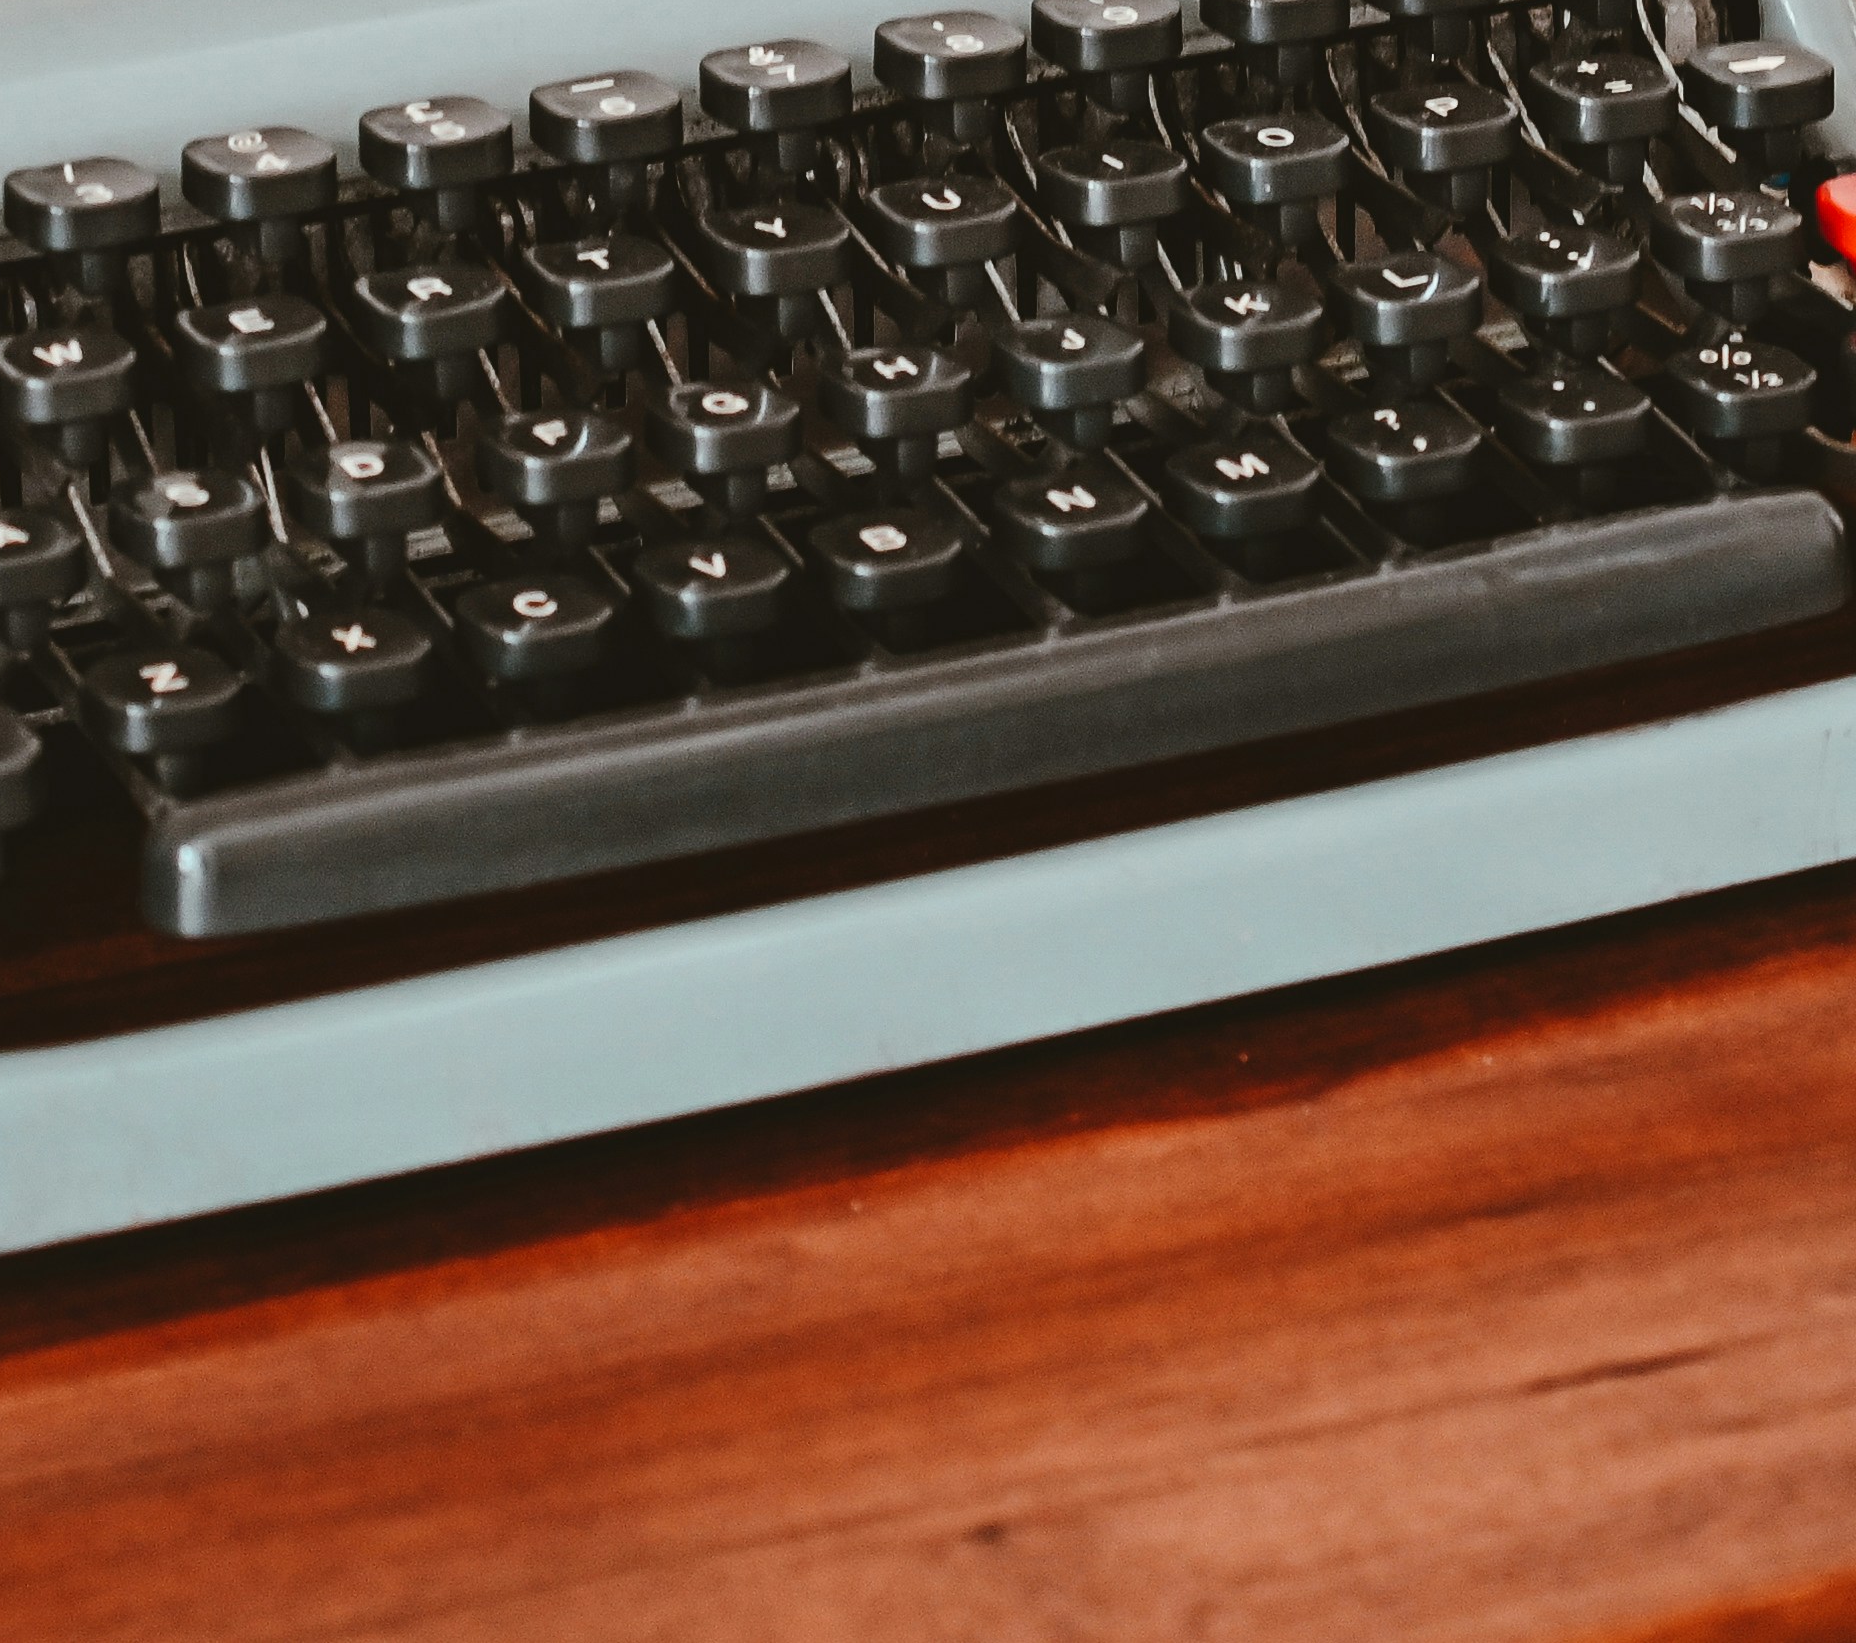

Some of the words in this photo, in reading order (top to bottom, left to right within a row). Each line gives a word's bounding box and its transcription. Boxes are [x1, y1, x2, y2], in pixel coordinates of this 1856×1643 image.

[33, 339, 83, 367] W
[407, 277, 453, 301] R
[577, 248, 609, 270] T
[754, 217, 786, 238] Y
[921, 188, 962, 210] U
[1257, 127, 1295, 147] O
[1425, 96, 1459, 117] P
[339, 453, 383, 478] D
[532, 420, 567, 446] F
[873, 356, 918, 380] H
[1224, 293, 1270, 315] K
[1382, 268, 1429, 288] L
[140, 663, 188, 693] Z
[332, 625, 376, 652] X
[513, 591, 557, 617] C
[690, 553, 726, 578] V
[1047, 486, 1096, 512] N
[1215, 453, 1270, 480] M
